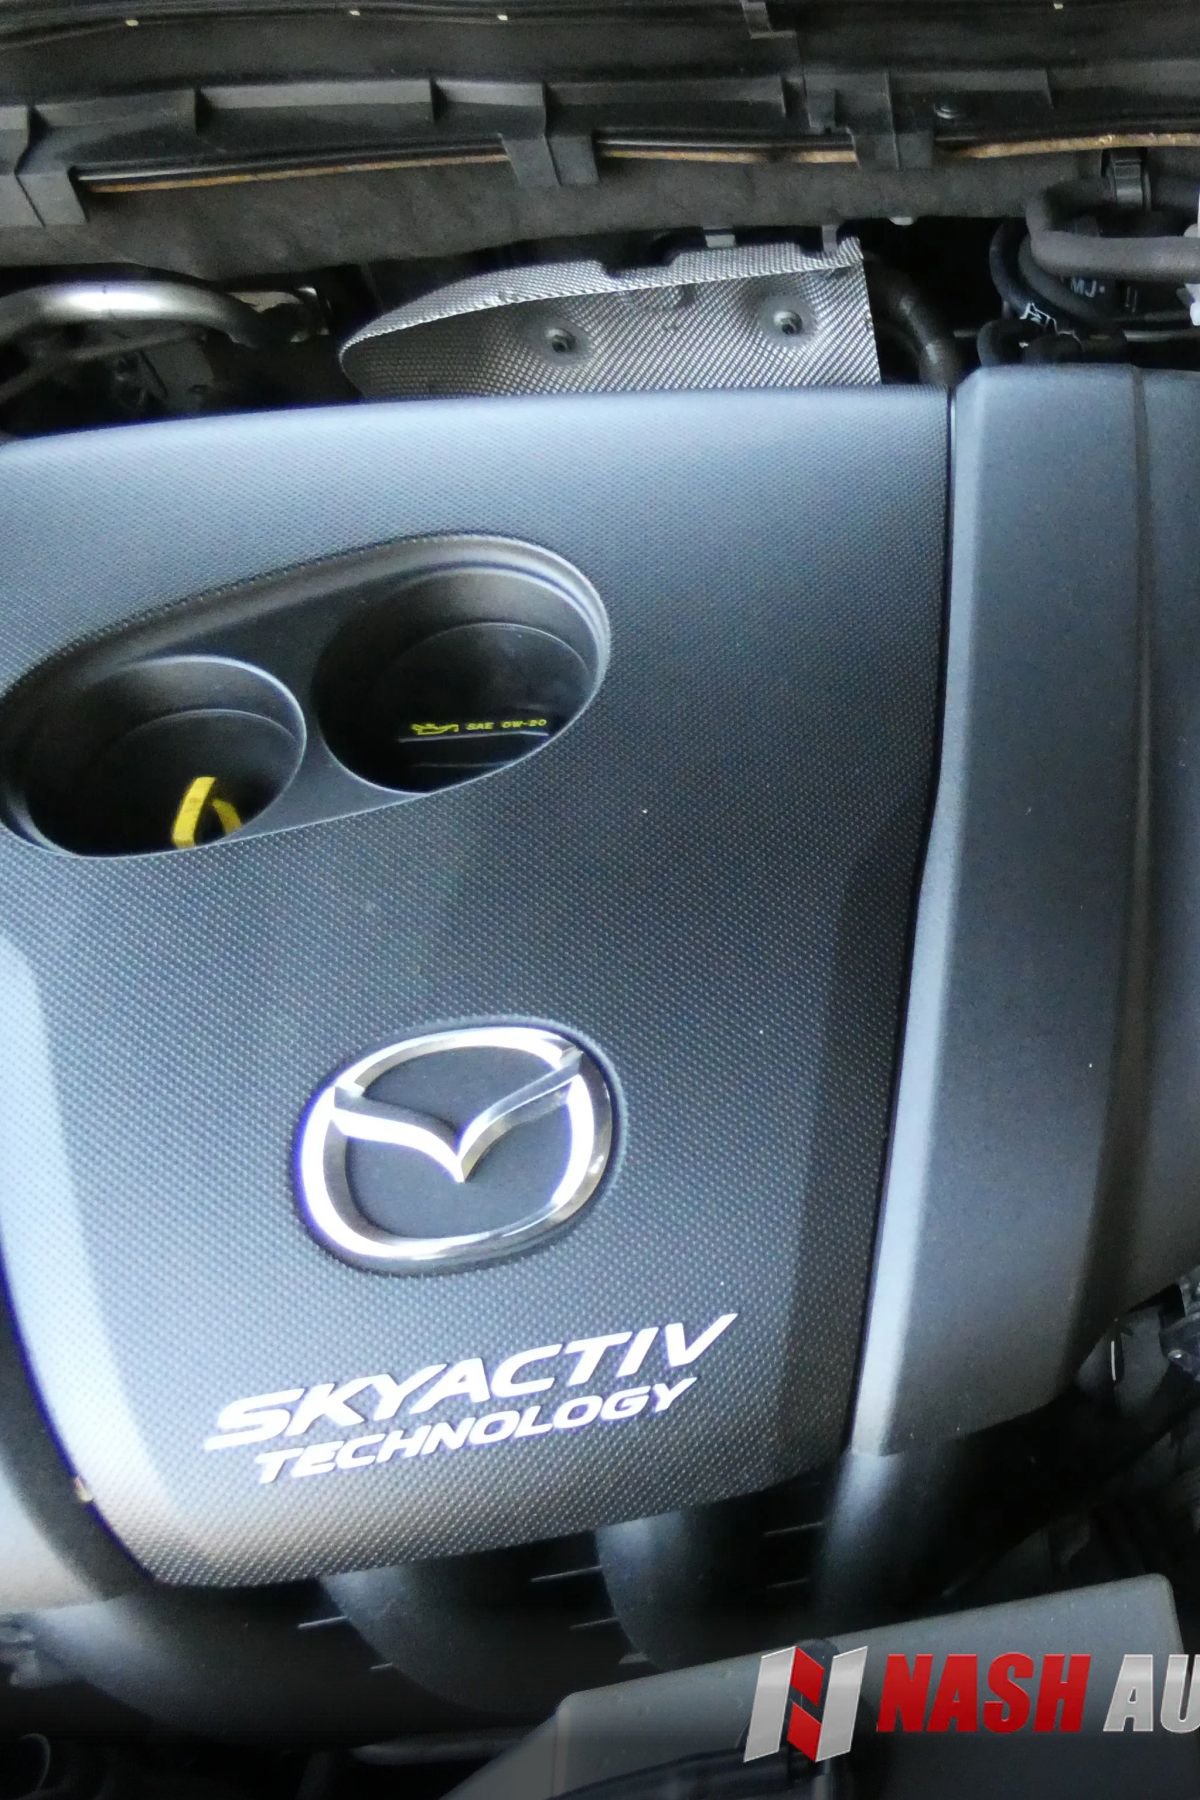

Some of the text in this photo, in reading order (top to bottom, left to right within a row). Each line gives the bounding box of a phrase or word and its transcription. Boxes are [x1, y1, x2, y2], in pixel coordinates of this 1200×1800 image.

[465, 718, 548, 731] SAE 0W-20
[204, 1312, 738, 1452] SKYACTIV
[253, 1376, 698, 1485] TECHNOLOGY
